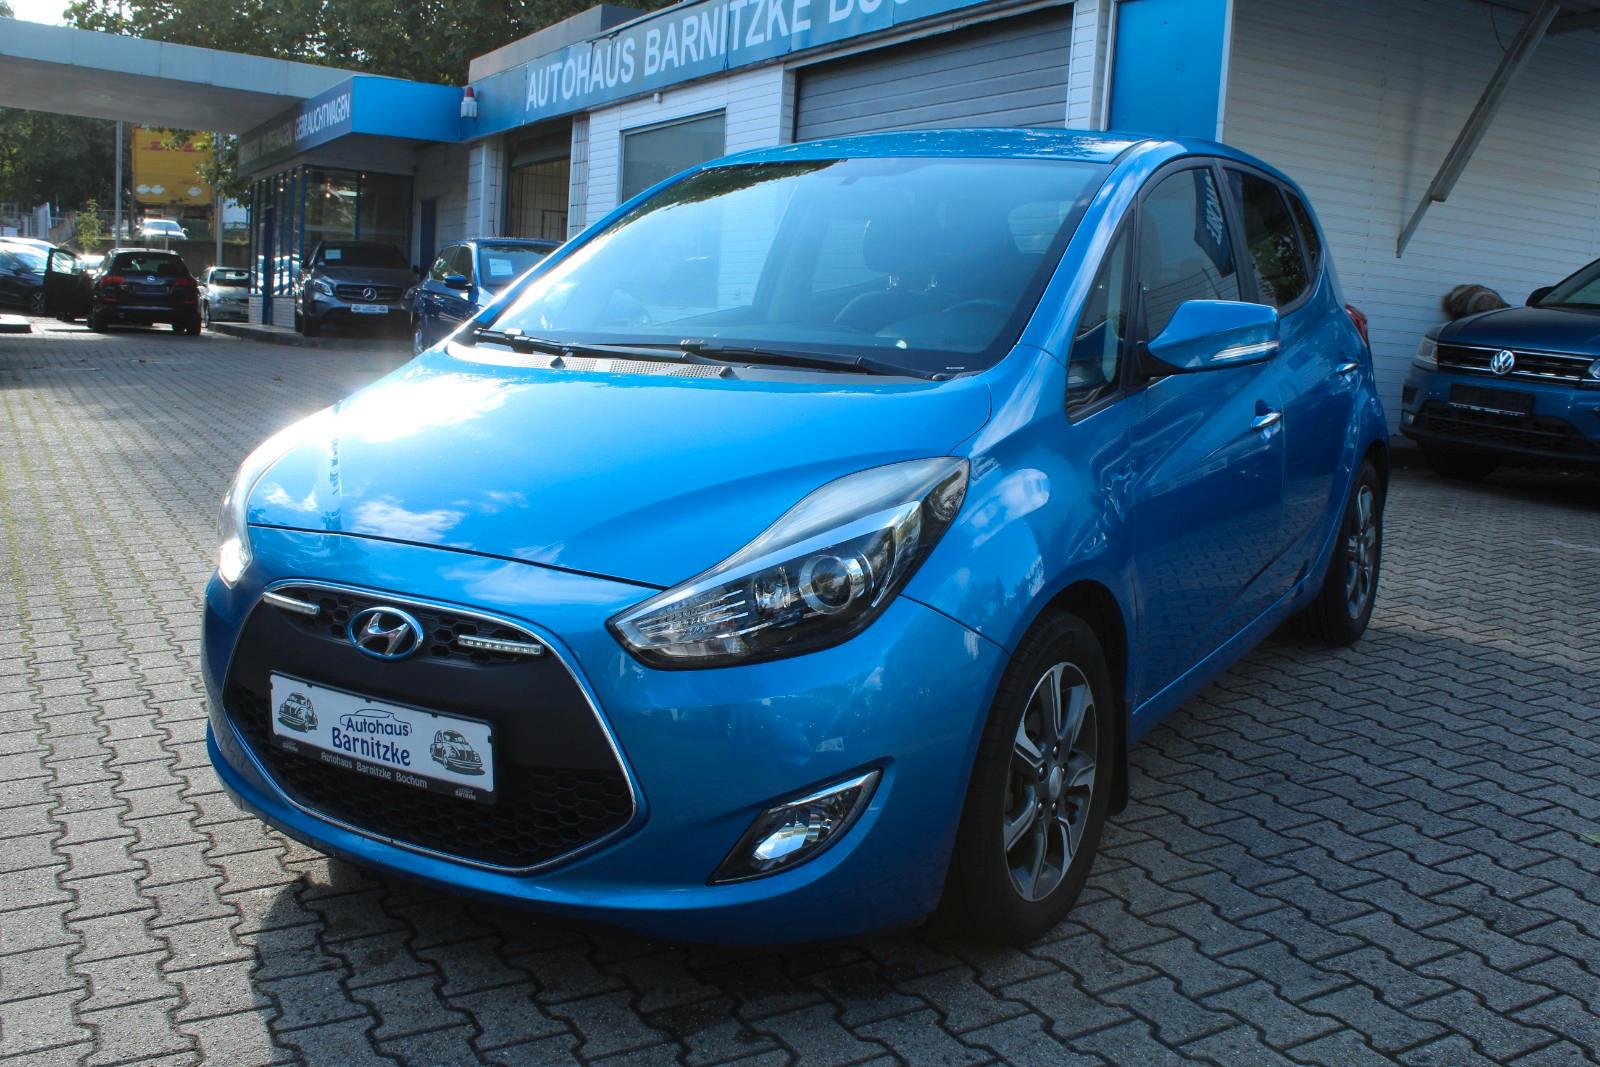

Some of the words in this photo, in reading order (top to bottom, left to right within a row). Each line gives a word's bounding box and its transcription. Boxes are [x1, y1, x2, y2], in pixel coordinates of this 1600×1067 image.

[525, 41, 635, 111] AUTOHAUS
[644, 0, 811, 77] BARNITZKE
[346, 717, 409, 736] Autohaus
[332, 726, 411, 767] Barnitzke
[321, 751, 353, 769] Autohaus
[356, 761, 392, 780] Barnitzke
[396, 771, 428, 789] Bochum
